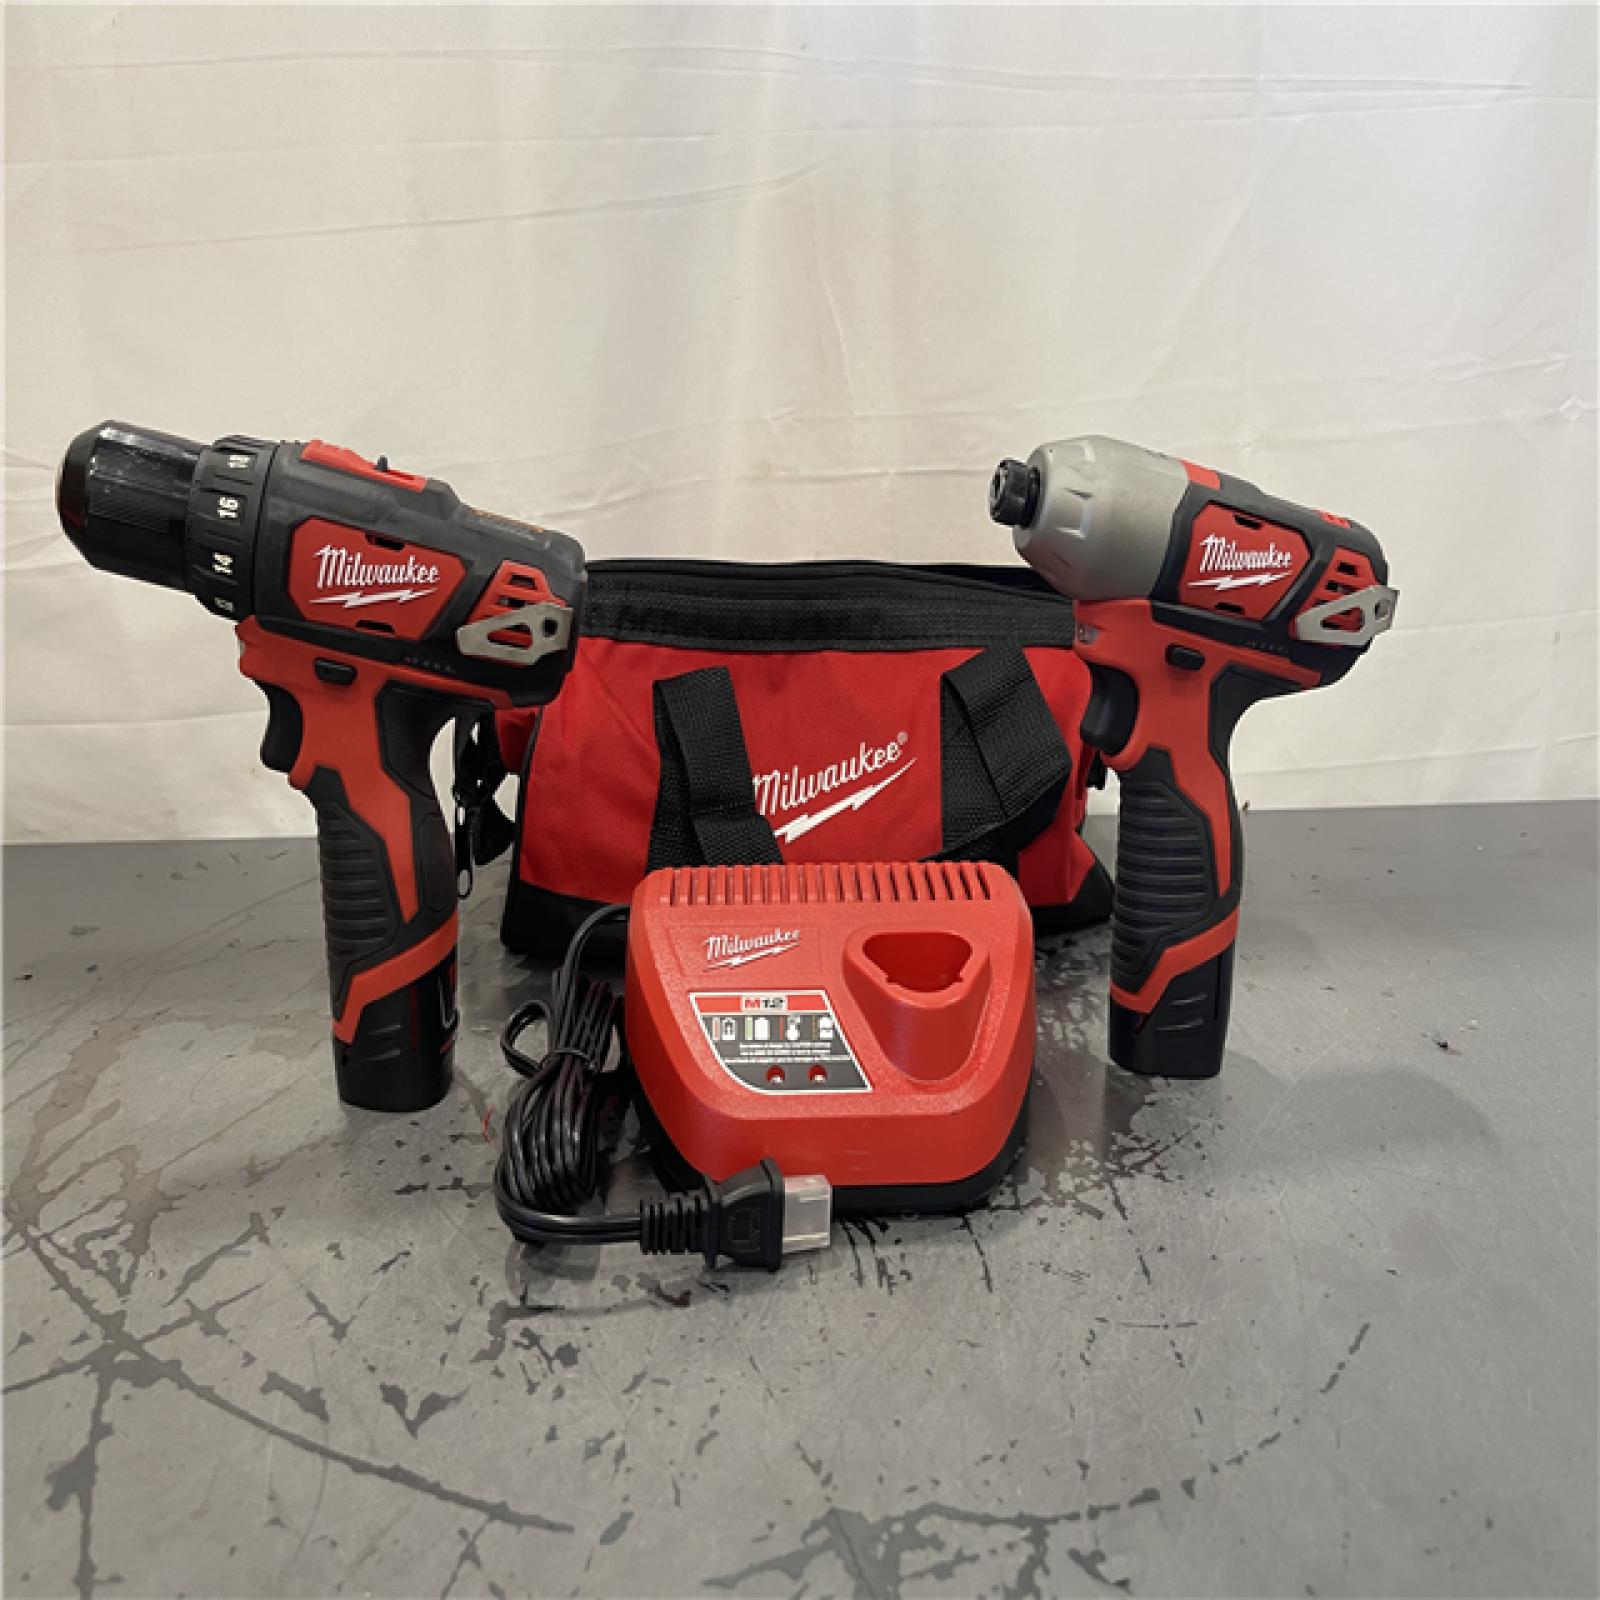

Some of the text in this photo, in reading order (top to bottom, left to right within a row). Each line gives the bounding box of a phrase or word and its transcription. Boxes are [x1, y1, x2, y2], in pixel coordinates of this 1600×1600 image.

[218, 497, 240, 518] 16
[313, 544, 440, 589] Milwaukee
[1200, 533, 1293, 573] Milwaukee
[704, 928, 801, 961] Milwaukee
